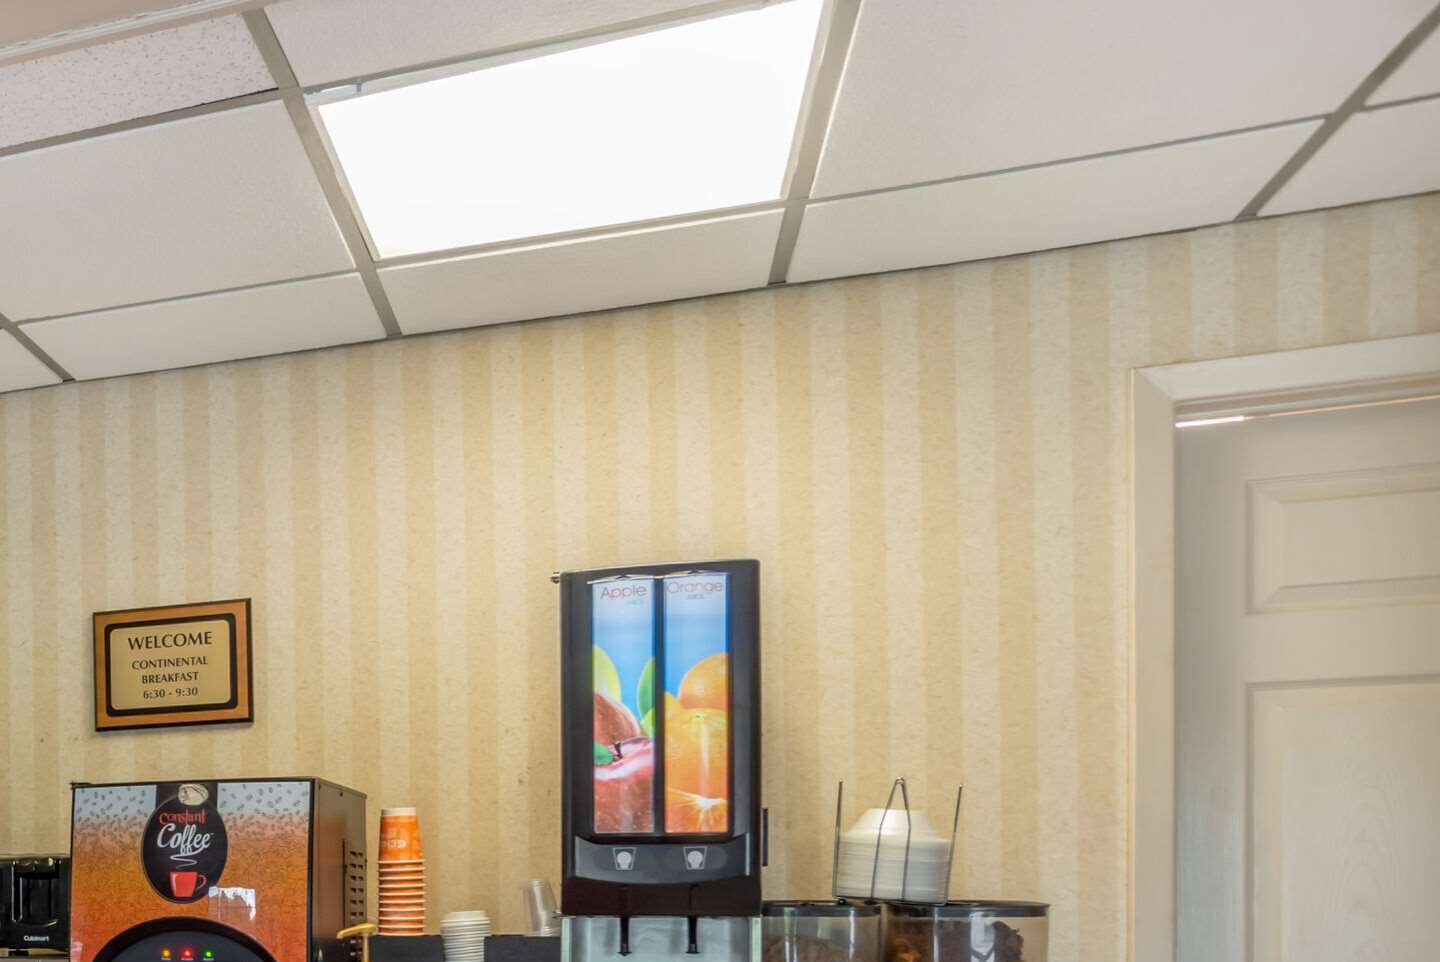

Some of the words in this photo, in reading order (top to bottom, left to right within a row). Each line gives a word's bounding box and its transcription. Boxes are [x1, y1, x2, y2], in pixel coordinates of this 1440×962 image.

[599, 585, 648, 599] Apple
[667, 581, 723, 593] Orange
[127, 631, 213, 651] WELCOME
[131, 656, 209, 671] CONTINENTAL
[141, 671, 200, 685] BREAKFAST
[143, 689, 166, 700] 6:30
[175, 686, 199, 698] 9:30
[157, 823, 212, 856] Coffee
